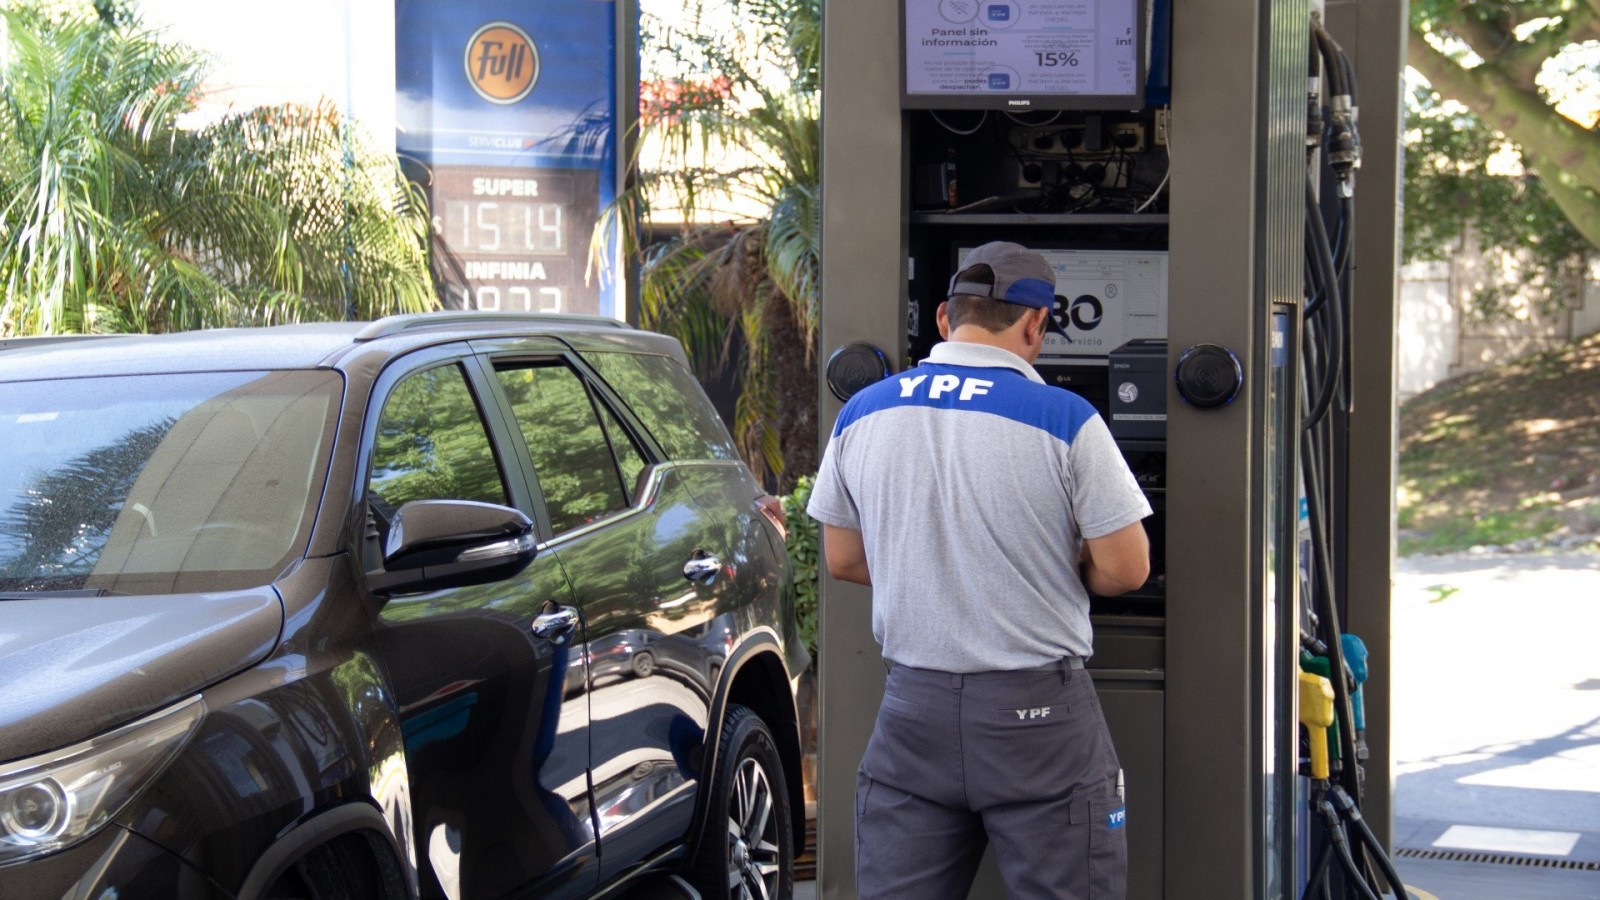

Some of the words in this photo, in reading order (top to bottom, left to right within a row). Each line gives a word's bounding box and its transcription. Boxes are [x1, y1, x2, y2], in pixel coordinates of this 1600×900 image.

[931, 28, 966, 36] Panel
[969, 28, 988, 36] sin
[921, 38, 998, 46] información
[477, 40, 526, 83] Full
[1035, 52, 1079, 67] 15%
[468, 136, 523, 149] SERVICLUB
[472, 177, 538, 197] SUPER
[465, 261, 546, 280] INFINIA
[899, 374, 994, 401] YPF
[1015, 706, 1051, 720] YPF
